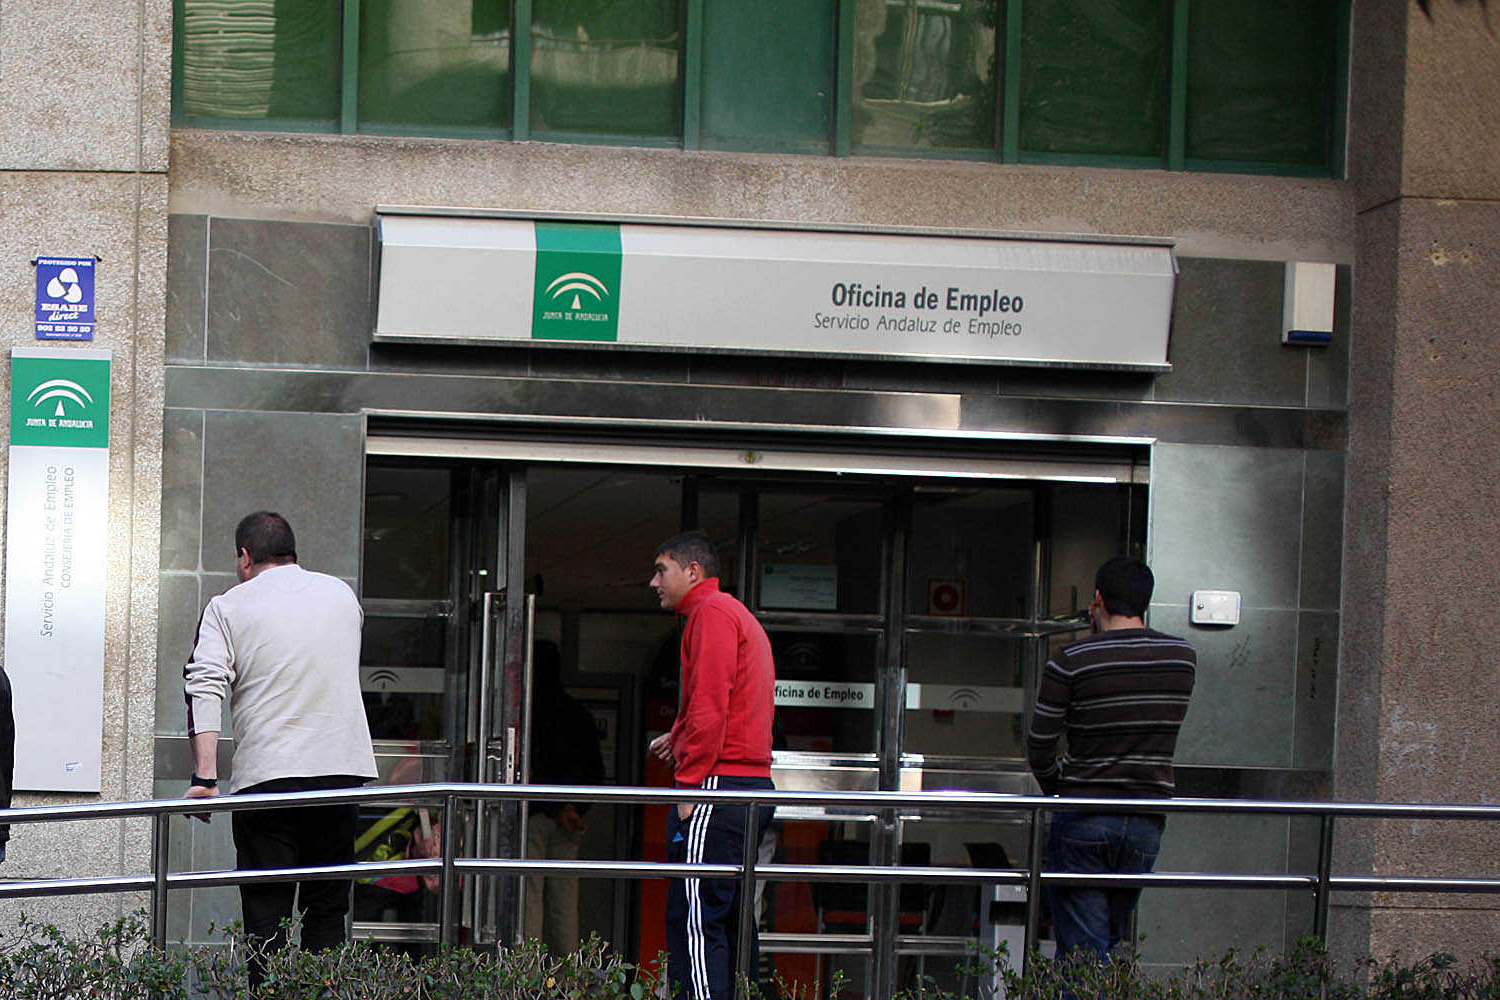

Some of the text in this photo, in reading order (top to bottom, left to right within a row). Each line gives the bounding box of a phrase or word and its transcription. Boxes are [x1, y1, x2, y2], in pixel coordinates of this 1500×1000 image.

[832, 283, 1024, 317] Oficina de Empleo
[41, 304, 88, 312] ESABE
[48, 312, 80, 321] direct
[565, 312, 572, 320] DE
[814, 312, 1022, 339] Servicio Andaluz de Empleo
[25, 418, 46, 426] JUNTA
[48, 419, 57, 427] DE
[64, 467, 74, 508] EMPLEO
[64, 512, 73, 524] DE
[40, 466, 59, 637] Servicio Andaluz de Empleo
[775, 685, 864, 702] ficina de Empleo
